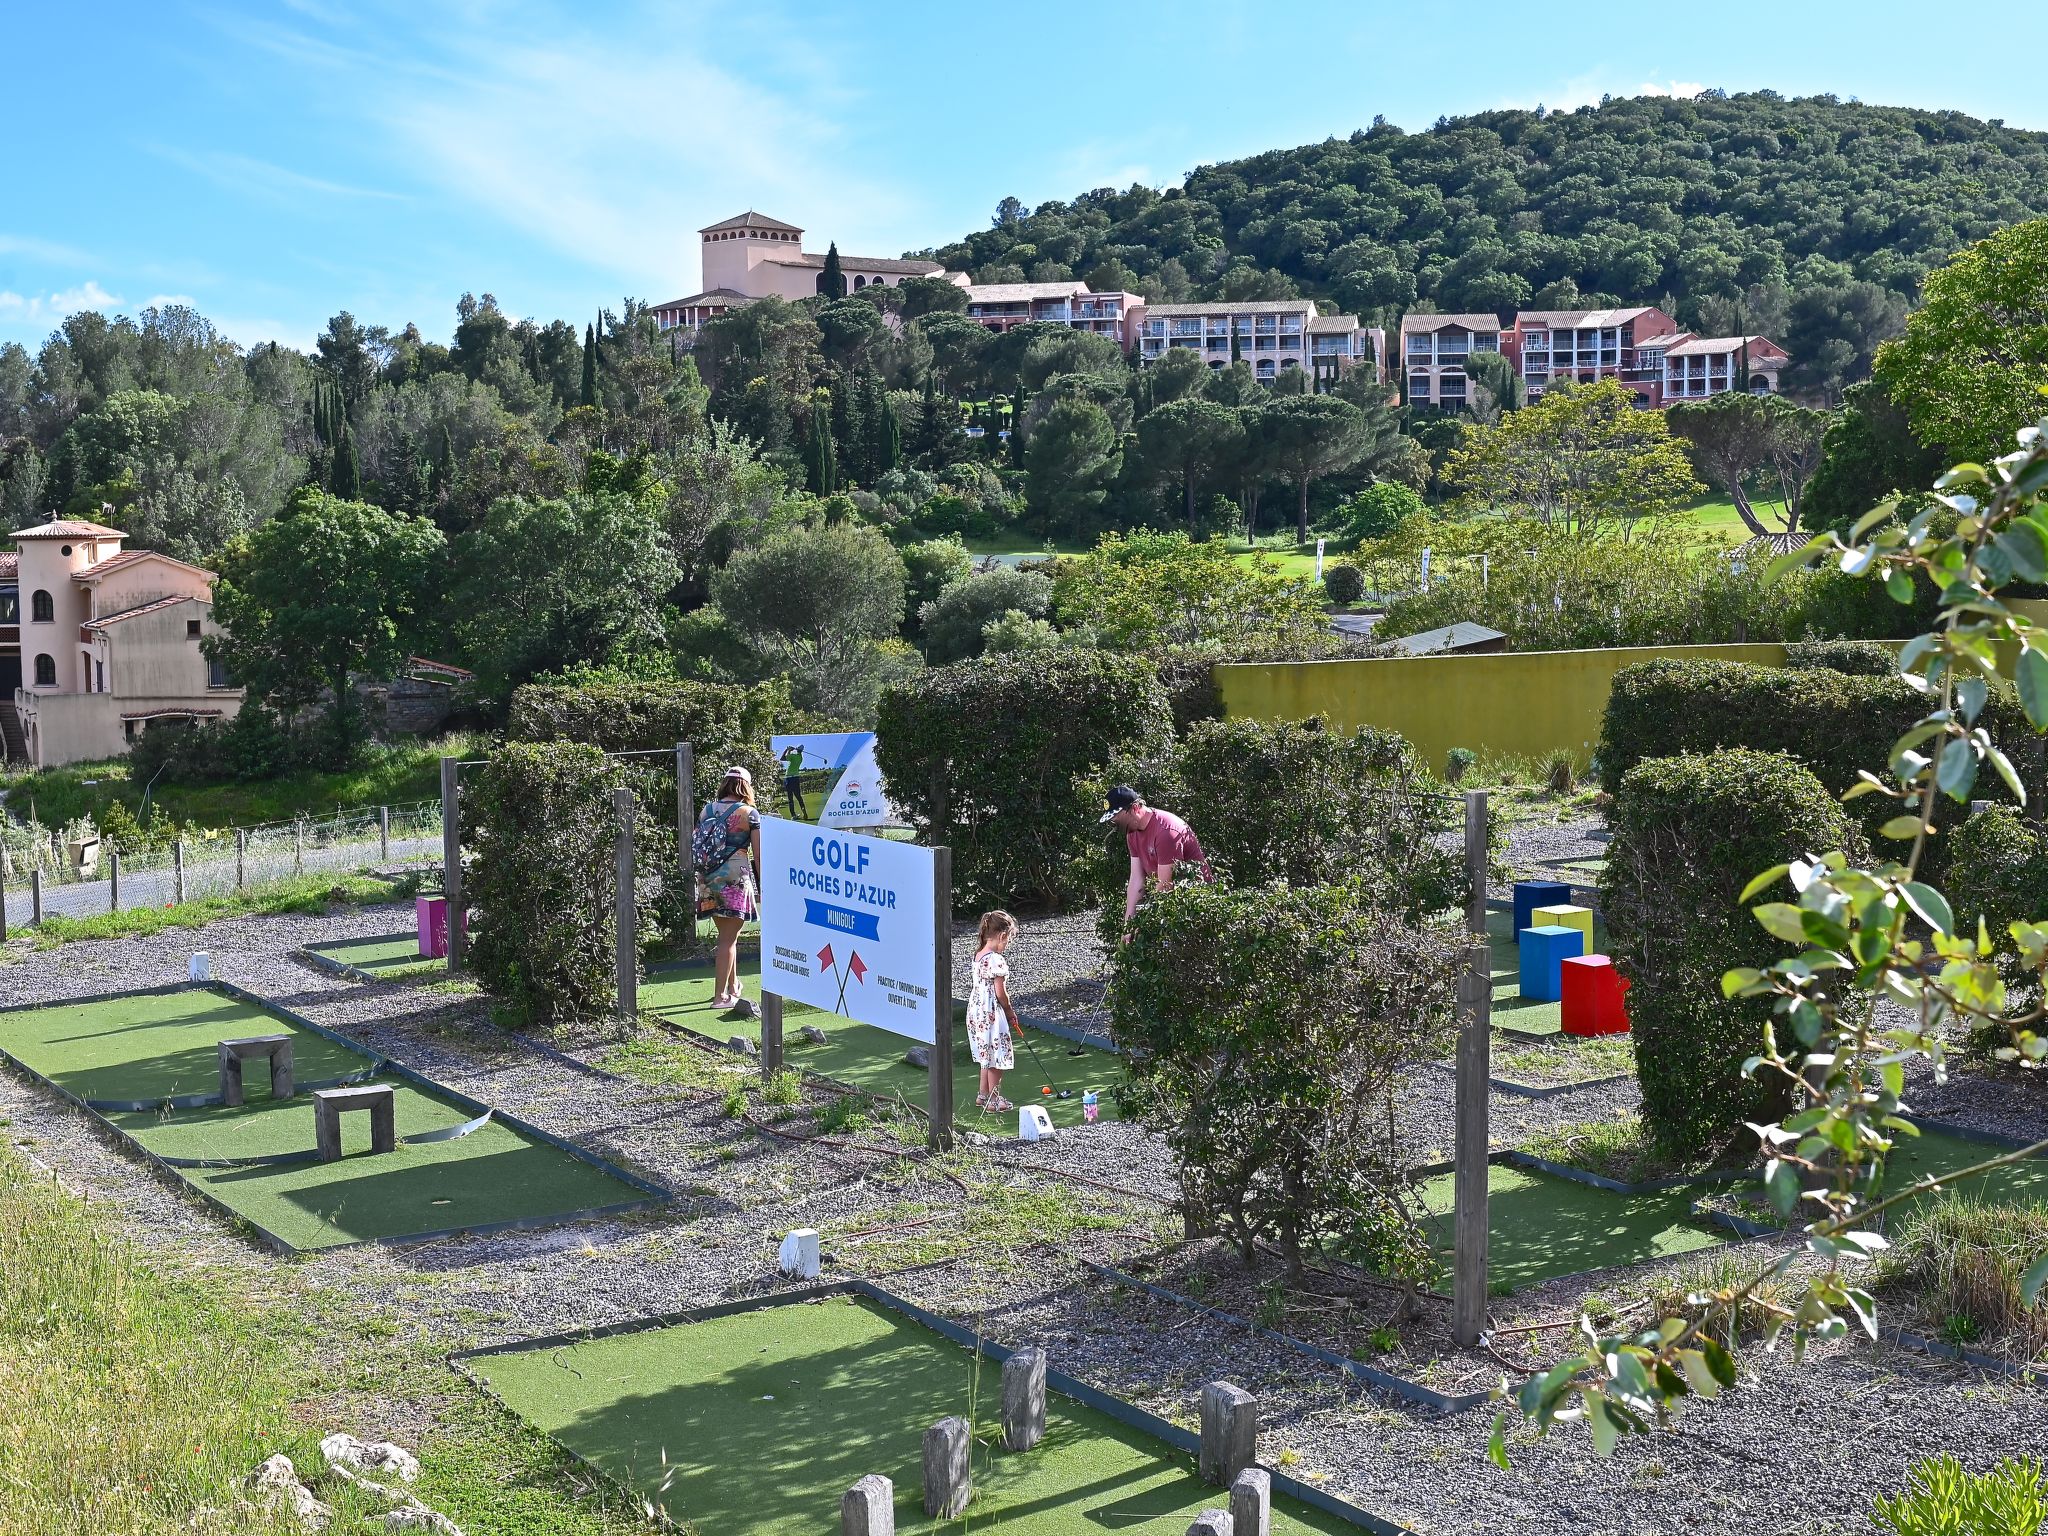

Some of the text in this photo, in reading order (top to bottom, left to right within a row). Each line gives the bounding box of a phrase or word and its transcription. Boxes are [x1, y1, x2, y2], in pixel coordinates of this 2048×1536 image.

[840, 800, 868, 810] GOLF
[812, 836, 870, 875] GOLF
[789, 867, 896, 909] ROCHES D'AZUR
[827, 909, 855, 930] MINIGOLF
[785, 962, 789, 971] AU
[799, 965, 810, 978] HOUSE
[877, 974, 895, 989] PRACTICE
[899, 981, 914, 995] DRIVING
[914, 985, 928, 999] RANGE
[888, 993, 902, 1007] OUVERT
[907, 998, 917, 1010] TOUS
